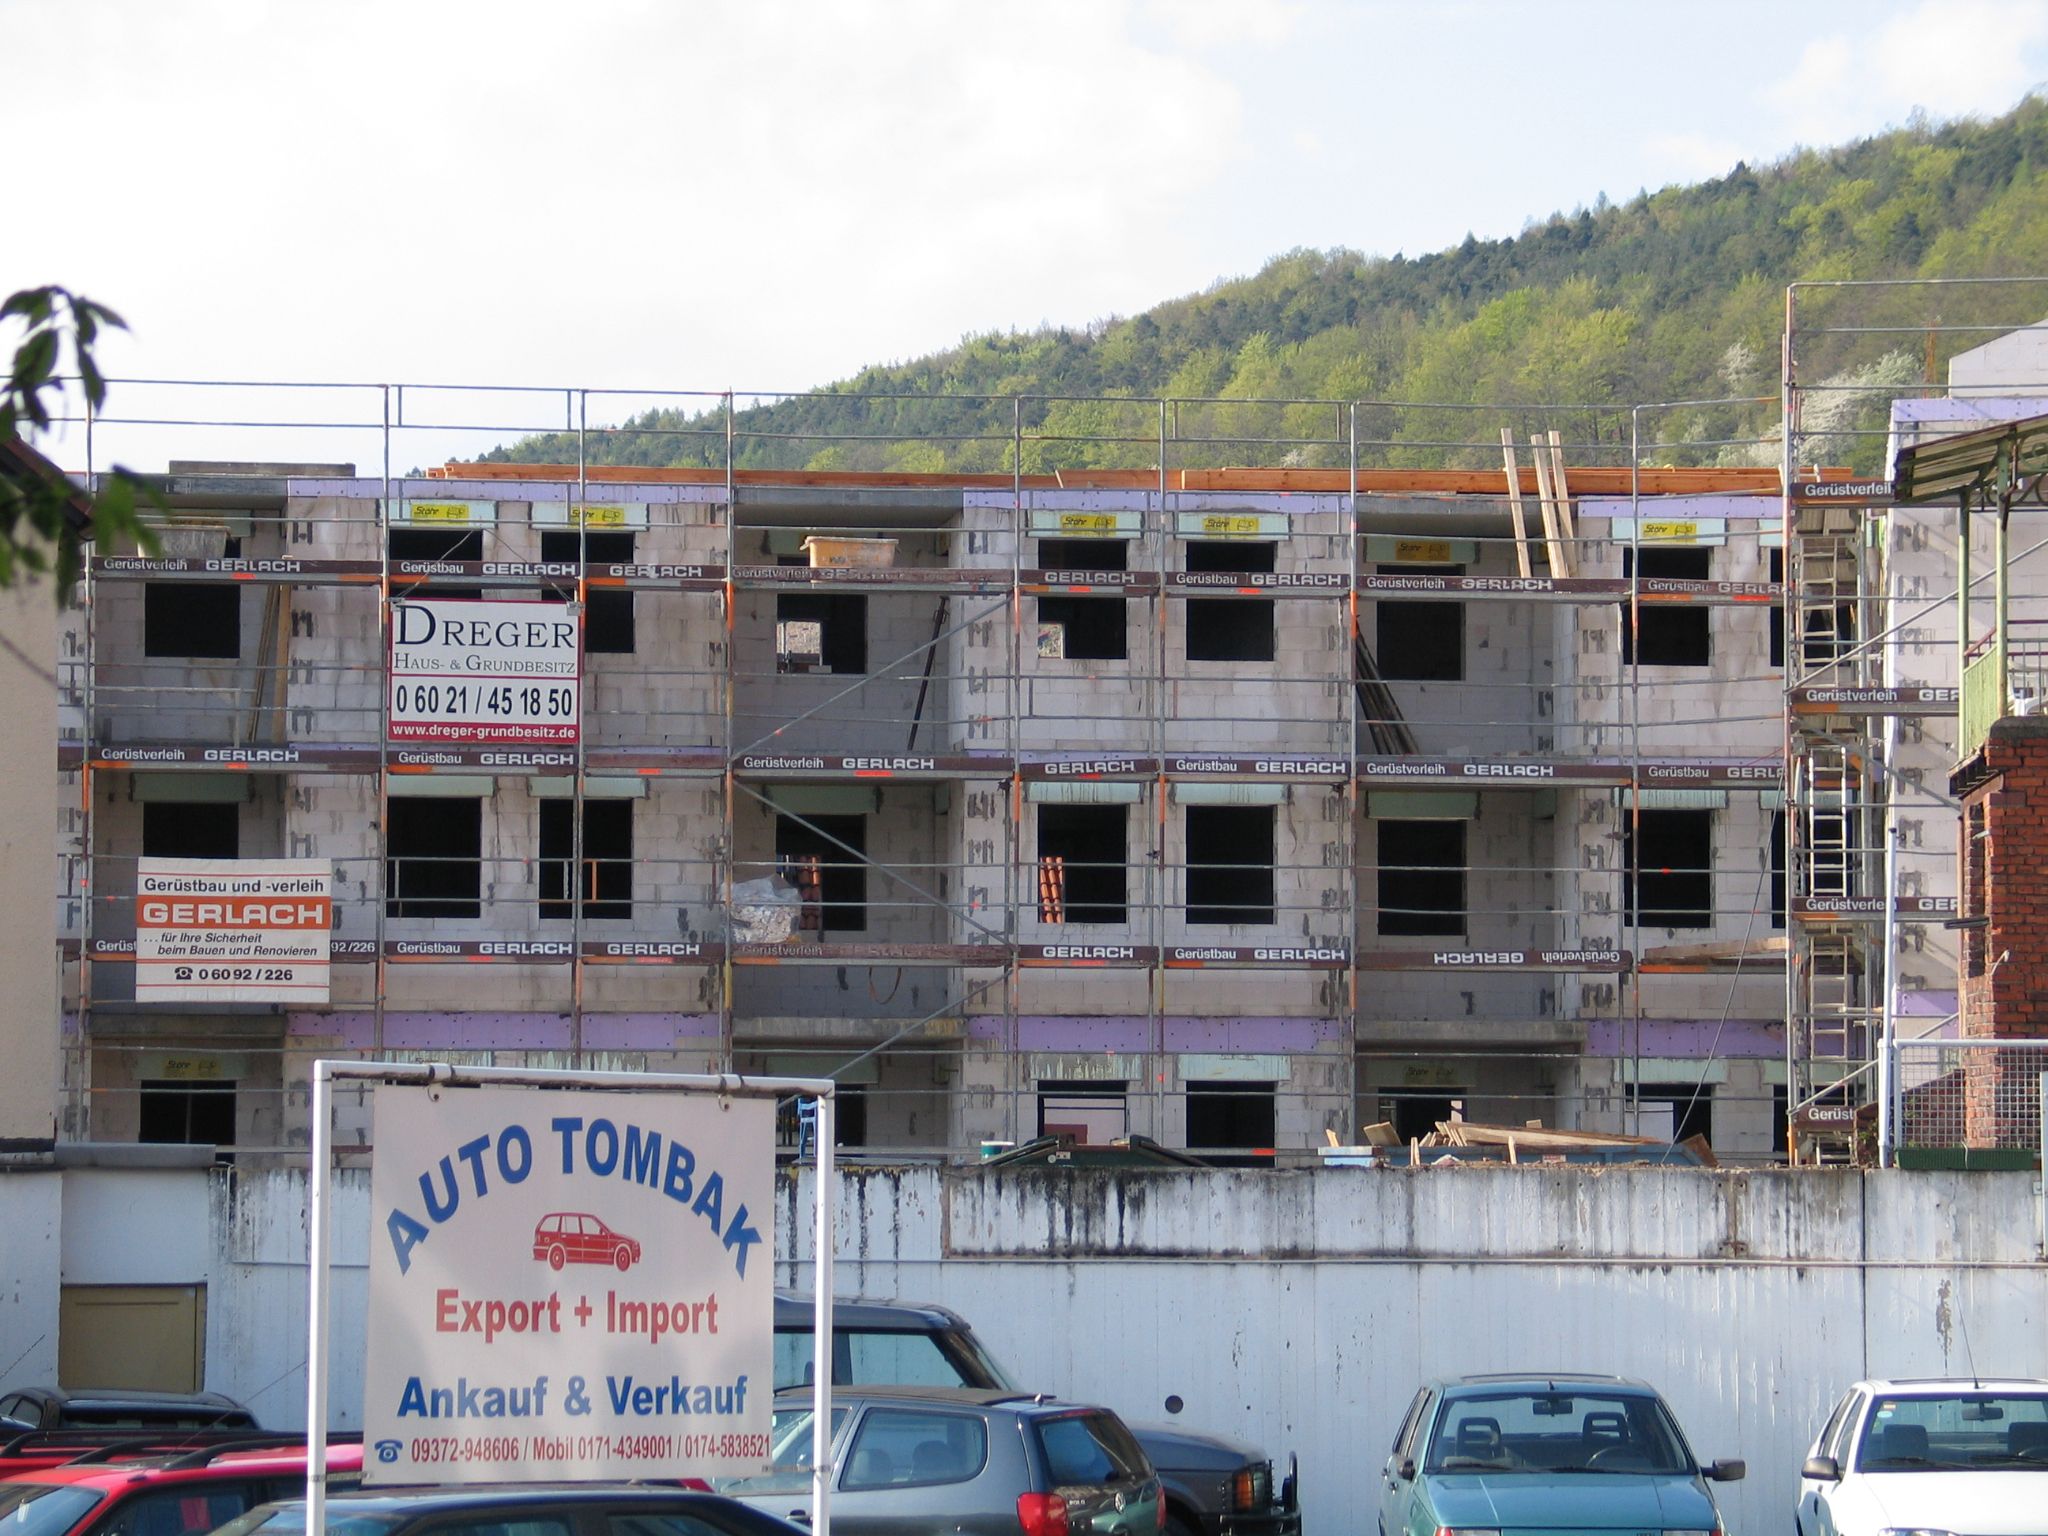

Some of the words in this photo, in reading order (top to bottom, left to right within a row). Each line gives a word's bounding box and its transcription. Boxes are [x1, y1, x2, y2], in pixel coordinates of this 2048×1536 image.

[104, 558, 188, 571] Gerüstverleih
[206, 560, 300, 572] GERLACH
[401, 560, 464, 575] Gerüstbau
[482, 563, 576, 576] GERLACH
[609, 564, 702, 578] GERLACH
[1044, 571, 1135, 584] GERLACH
[1176, 572, 1237, 585] Gerüstbau
[1251, 574, 1341, 586] GERLACH
[1366, 576, 1445, 589] Gerüstverleih
[1461, 578, 1553, 590] GERLACH
[395, 604, 576, 649] DREGER
[450, 659, 461, 670] &
[465, 654, 576, 674] GRUNDBESITZ
[396, 684, 408, 713] 0
[414, 685, 439, 714] 60
[446, 686, 467, 714] 21
[487, 687, 513, 715] 45
[520, 687, 541, 715] 18
[548, 688, 572, 716] 50
[1806, 689, 1897, 702] Gerüstverleih
[392, 724, 576, 739] www.dreger-grundbesitz.de
[101, 748, 185, 761] Gerüstverleih
[204, 750, 299, 762] GERLACH
[398, 751, 462, 765] Gerüstbau
[480, 753, 574, 766] GERLACH
[743, 757, 824, 769] Gerüstverleih
[842, 758, 935, 770] GERLACH
[1044, 761, 1135, 774] GERLACH
[1176, 759, 1238, 773] Gerüstbau
[1255, 761, 1346, 774] GERLACH
[1367, 762, 1446, 776] Gerüstverleih
[1463, 764, 1554, 777] GERLACH
[1648, 766, 1709, 778] Gerüstbau
[144, 878, 227, 893] Gerüstbau
[232, 880, 261, 893] und
[265, 879, 324, 893] -verleih
[143, 902, 324, 925] GERLACH
[161, 932, 177, 944] für
[180, 933, 202, 944] Ihre
[204, 932, 262, 944] Sicherheit
[157, 945, 186, 956] beim
[189, 945, 224, 956] Bauen
[228, 946, 250, 957] und
[253, 946, 318, 957] Renovieren
[397, 942, 461, 954] Gerüstbau
[479, 942, 573, 955] GERLACH
[607, 943, 700, 956] GERLACH
[1042, 946, 1134, 959] GERLACH
[1175, 947, 1237, 960] Gerüstbau
[1254, 948, 1345, 961] GERLACH
[1433, 952, 1524, 964] GERLACH
[1541, 951, 1620, 963] Gerüstverleih
[264, 969, 293, 981] 226
[386, 1124, 533, 1277] AUTO
[551, 1117, 762, 1281] TOMBAK
[436, 1289, 561, 1344] Export
[574, 1295, 593, 1327] +
[607, 1290, 718, 1344] Import
[397, 1375, 548, 1418] Ankauf
[564, 1375, 592, 1416] &
[606, 1375, 748, 1415] Verkauf
[411, 1437, 520, 1463] 09372-948606
[533, 1436, 574, 1461] Mobil
[578, 1435, 672, 1460] 0171-4349001
[685, 1434, 770, 1458] 0174-5838521
